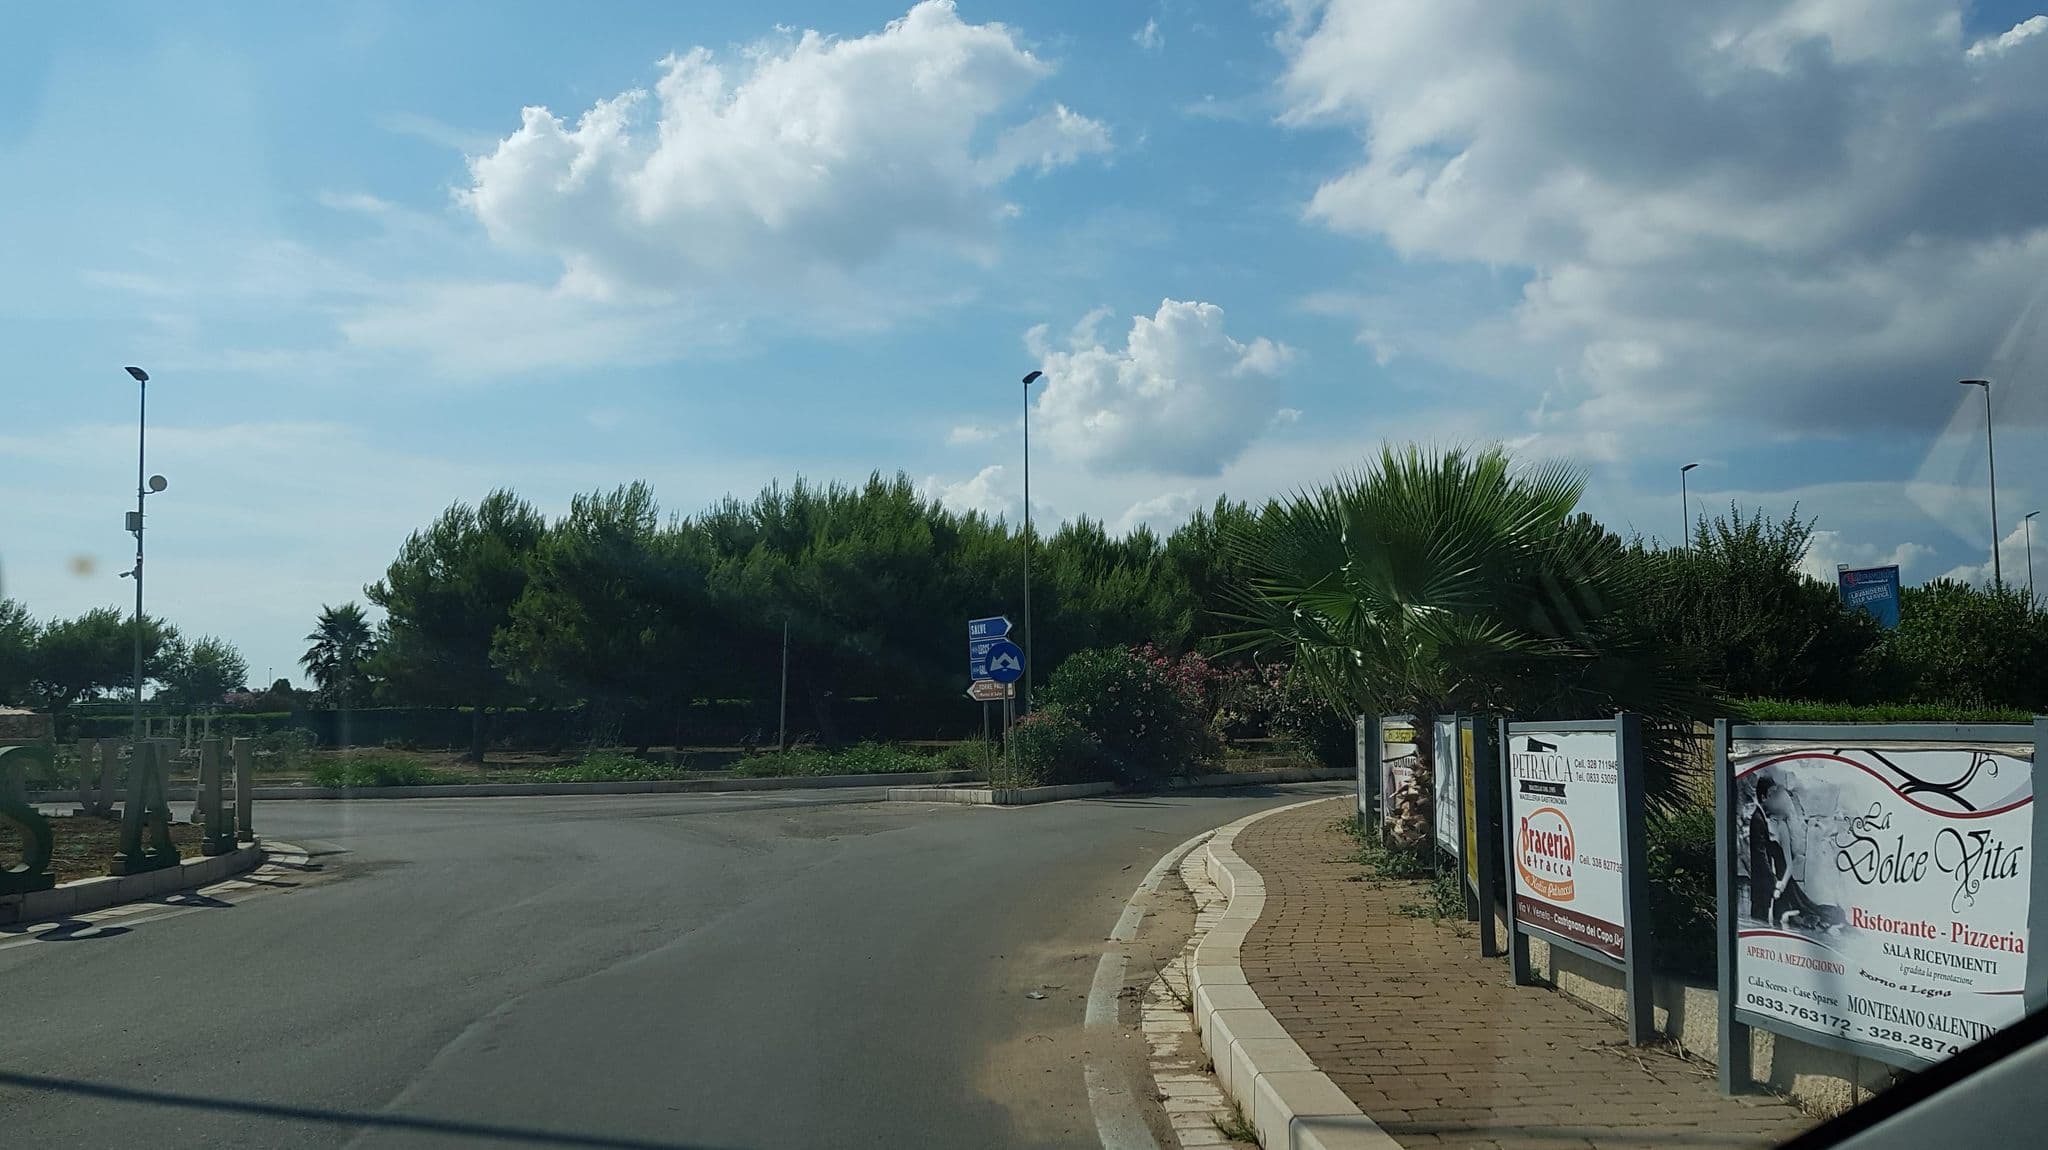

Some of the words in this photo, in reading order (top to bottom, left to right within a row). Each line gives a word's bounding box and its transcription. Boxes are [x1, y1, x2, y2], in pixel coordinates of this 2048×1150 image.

[971, 624, 987, 635] SALVE
[1512, 753, 1573, 783] PETRACCA
[1586, 772, 1600, 783] 0833
[1864, 802, 1893, 832] La
[1522, 817, 1572, 861] Braceria
[1836, 821, 1929, 885] Dolce
[1935, 828, 2024, 913] Vita
[1554, 913, 1585, 933] Castrignano
[1586, 924, 1596, 936] del
[1596, 928, 1613, 943] Capo
[1852, 907, 1937, 940] Ristorante
[1951, 921, 2025, 954] Pizzeria
[1747, 945, 1776, 961] APERTO
[1778, 952, 1783, 963] A
[1785, 953, 1845, 975] MEZZOGIORNO
[1883, 942, 1911, 961] SALA
[1914, 948, 1998, 975] RICEVIMENTI
[1903, 964, 1925, 976] gradita
[1926, 969, 1933, 977] la
[1933, 970, 1973, 986] prenotazione
[1793, 986, 1811, 999] Case
[1812, 990, 1838, 1007] Sparse
[1910, 984, 1952, 998] Legna
[1747, 993, 1851, 1032] 0833.763172
[1847, 995, 1925, 1028] MONTESANO
